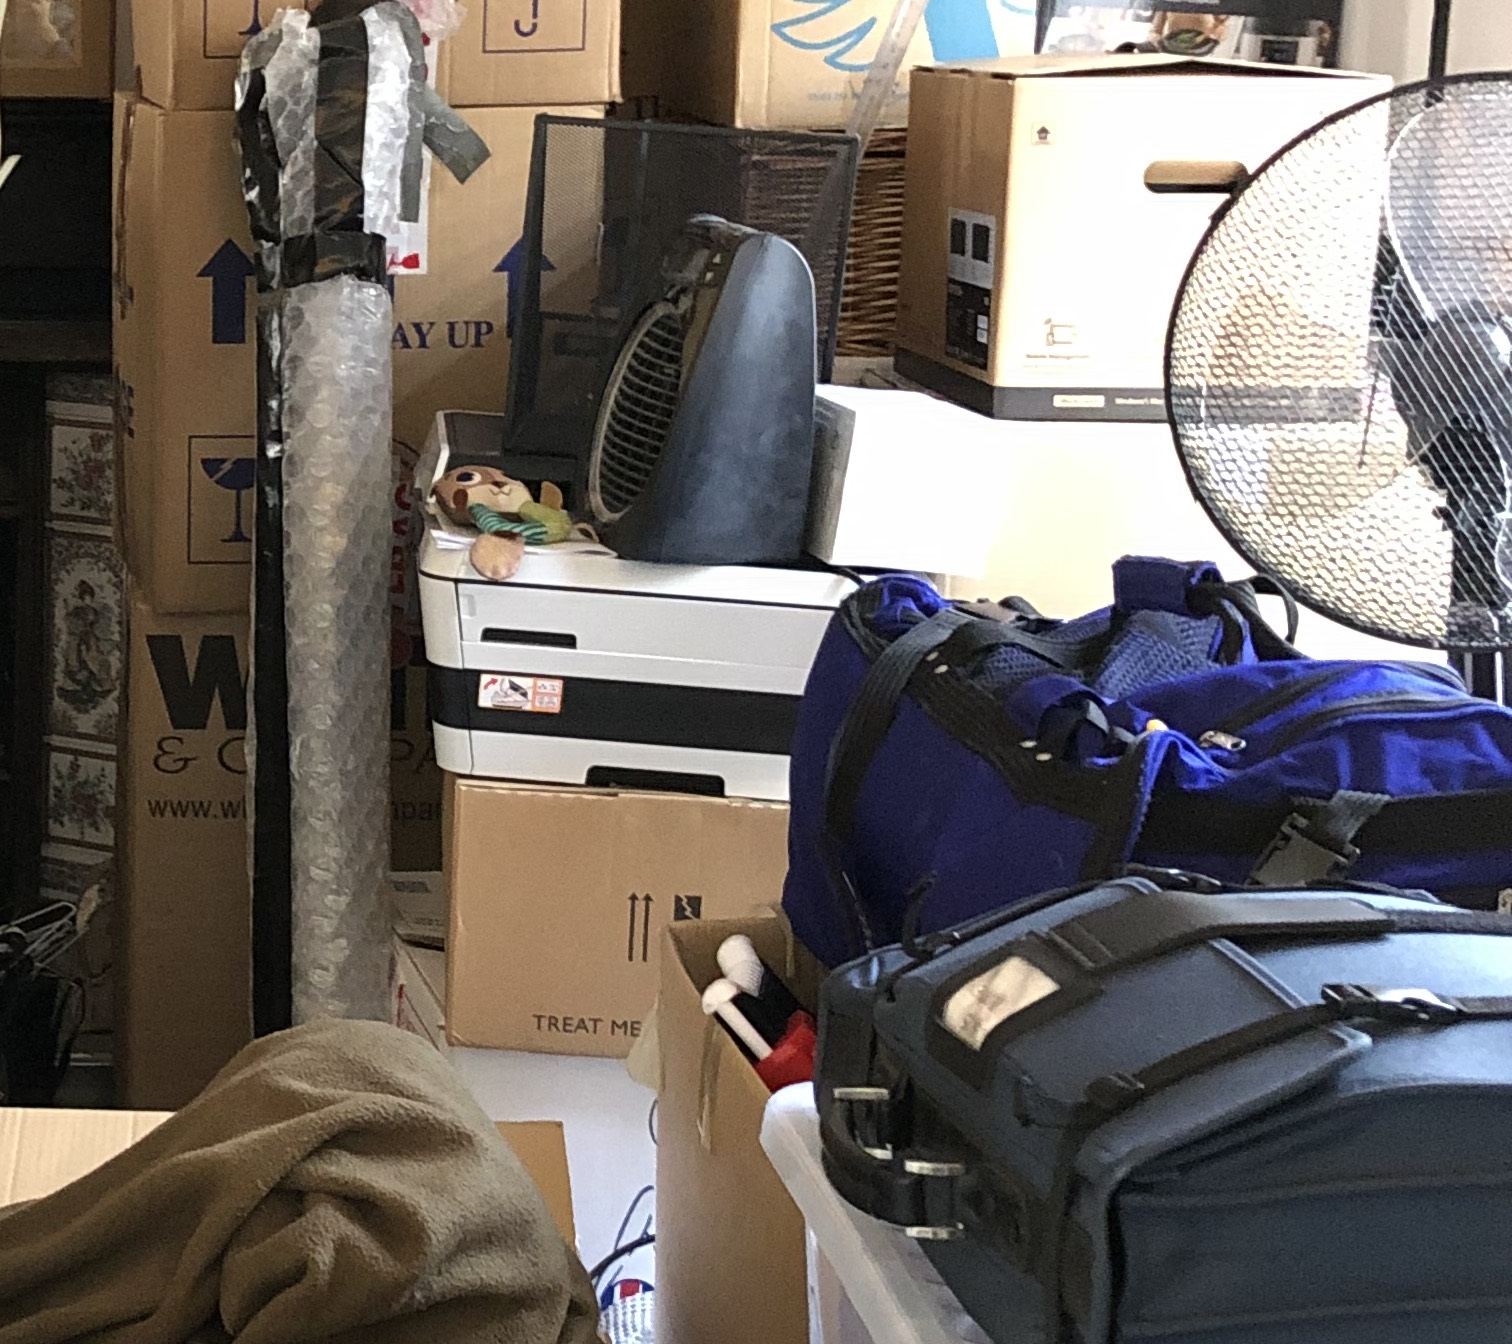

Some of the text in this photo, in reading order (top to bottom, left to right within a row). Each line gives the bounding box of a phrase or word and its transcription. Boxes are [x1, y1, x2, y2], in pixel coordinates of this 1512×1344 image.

[392, 320, 494, 350] AY UP
[532, 1014, 642, 1037] TREAT ME
